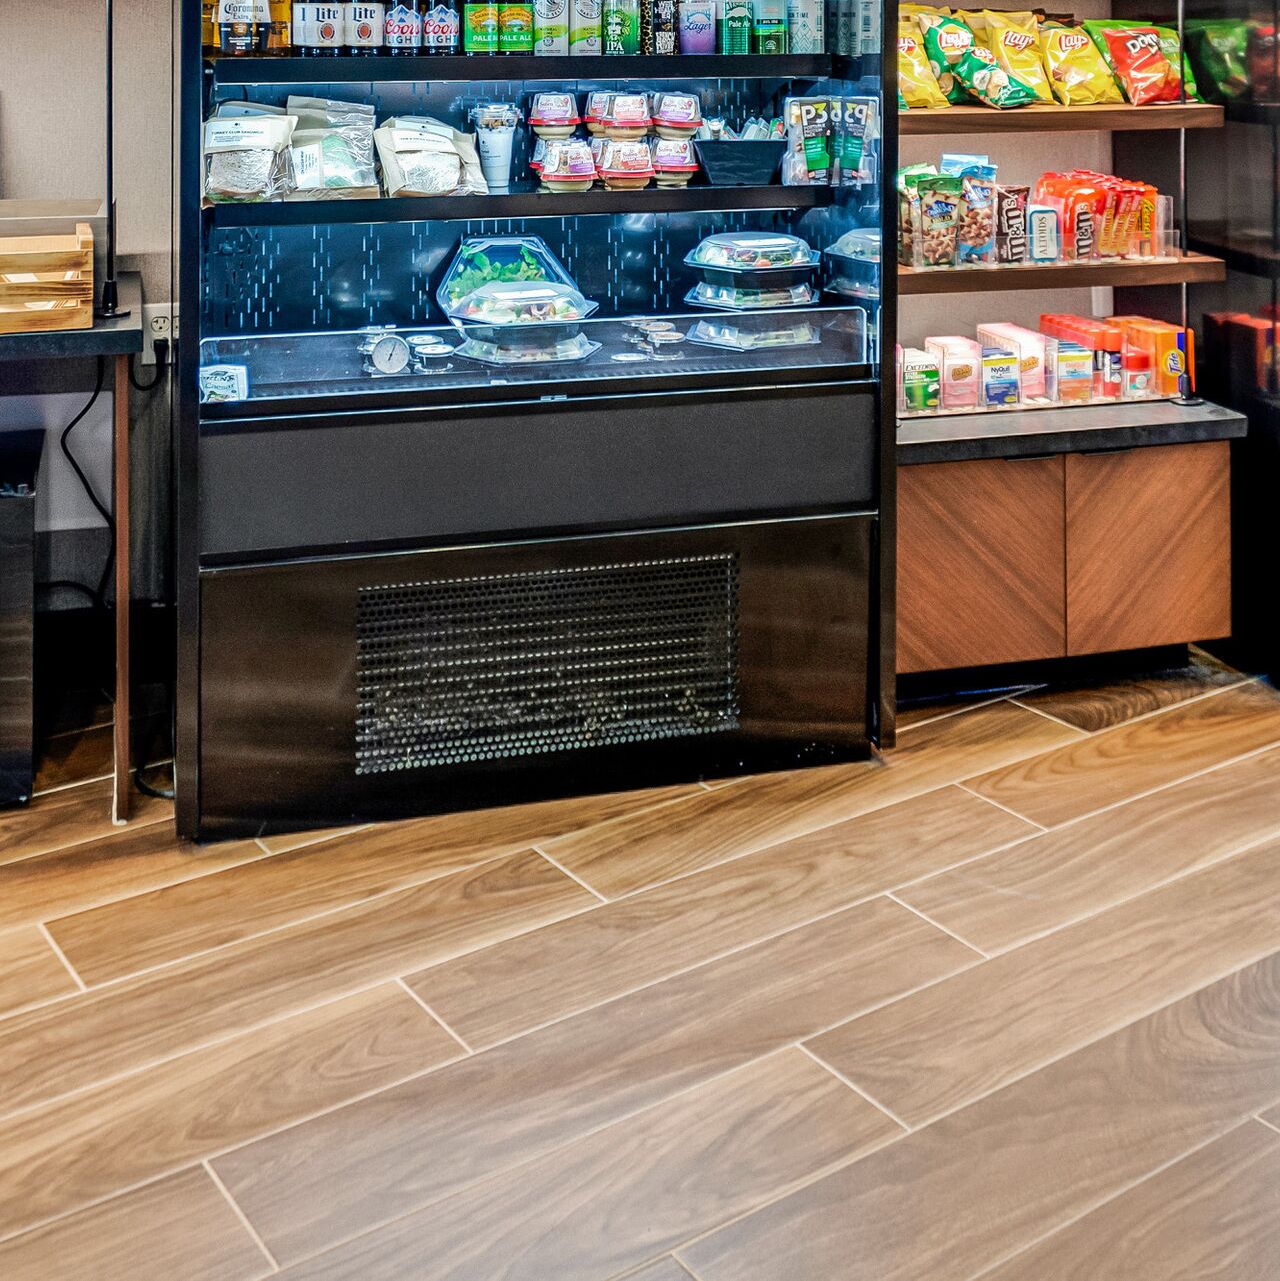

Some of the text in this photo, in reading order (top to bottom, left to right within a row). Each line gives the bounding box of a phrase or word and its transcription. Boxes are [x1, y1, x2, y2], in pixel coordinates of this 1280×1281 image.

[315, 7, 338, 21] Lite
[352, 6, 375, 20] Lite
[385, 20, 420, 35] Coors
[424, 20, 459, 35] Coors
[684, 20, 712, 34] Lager
[387, 35, 418, 45] LIGHT
[426, 35, 458, 45] LIGHT
[606, 41, 624, 51] IPA
[801, 103, 828, 126] P3
[1169, 352, 1182, 373] Tide
